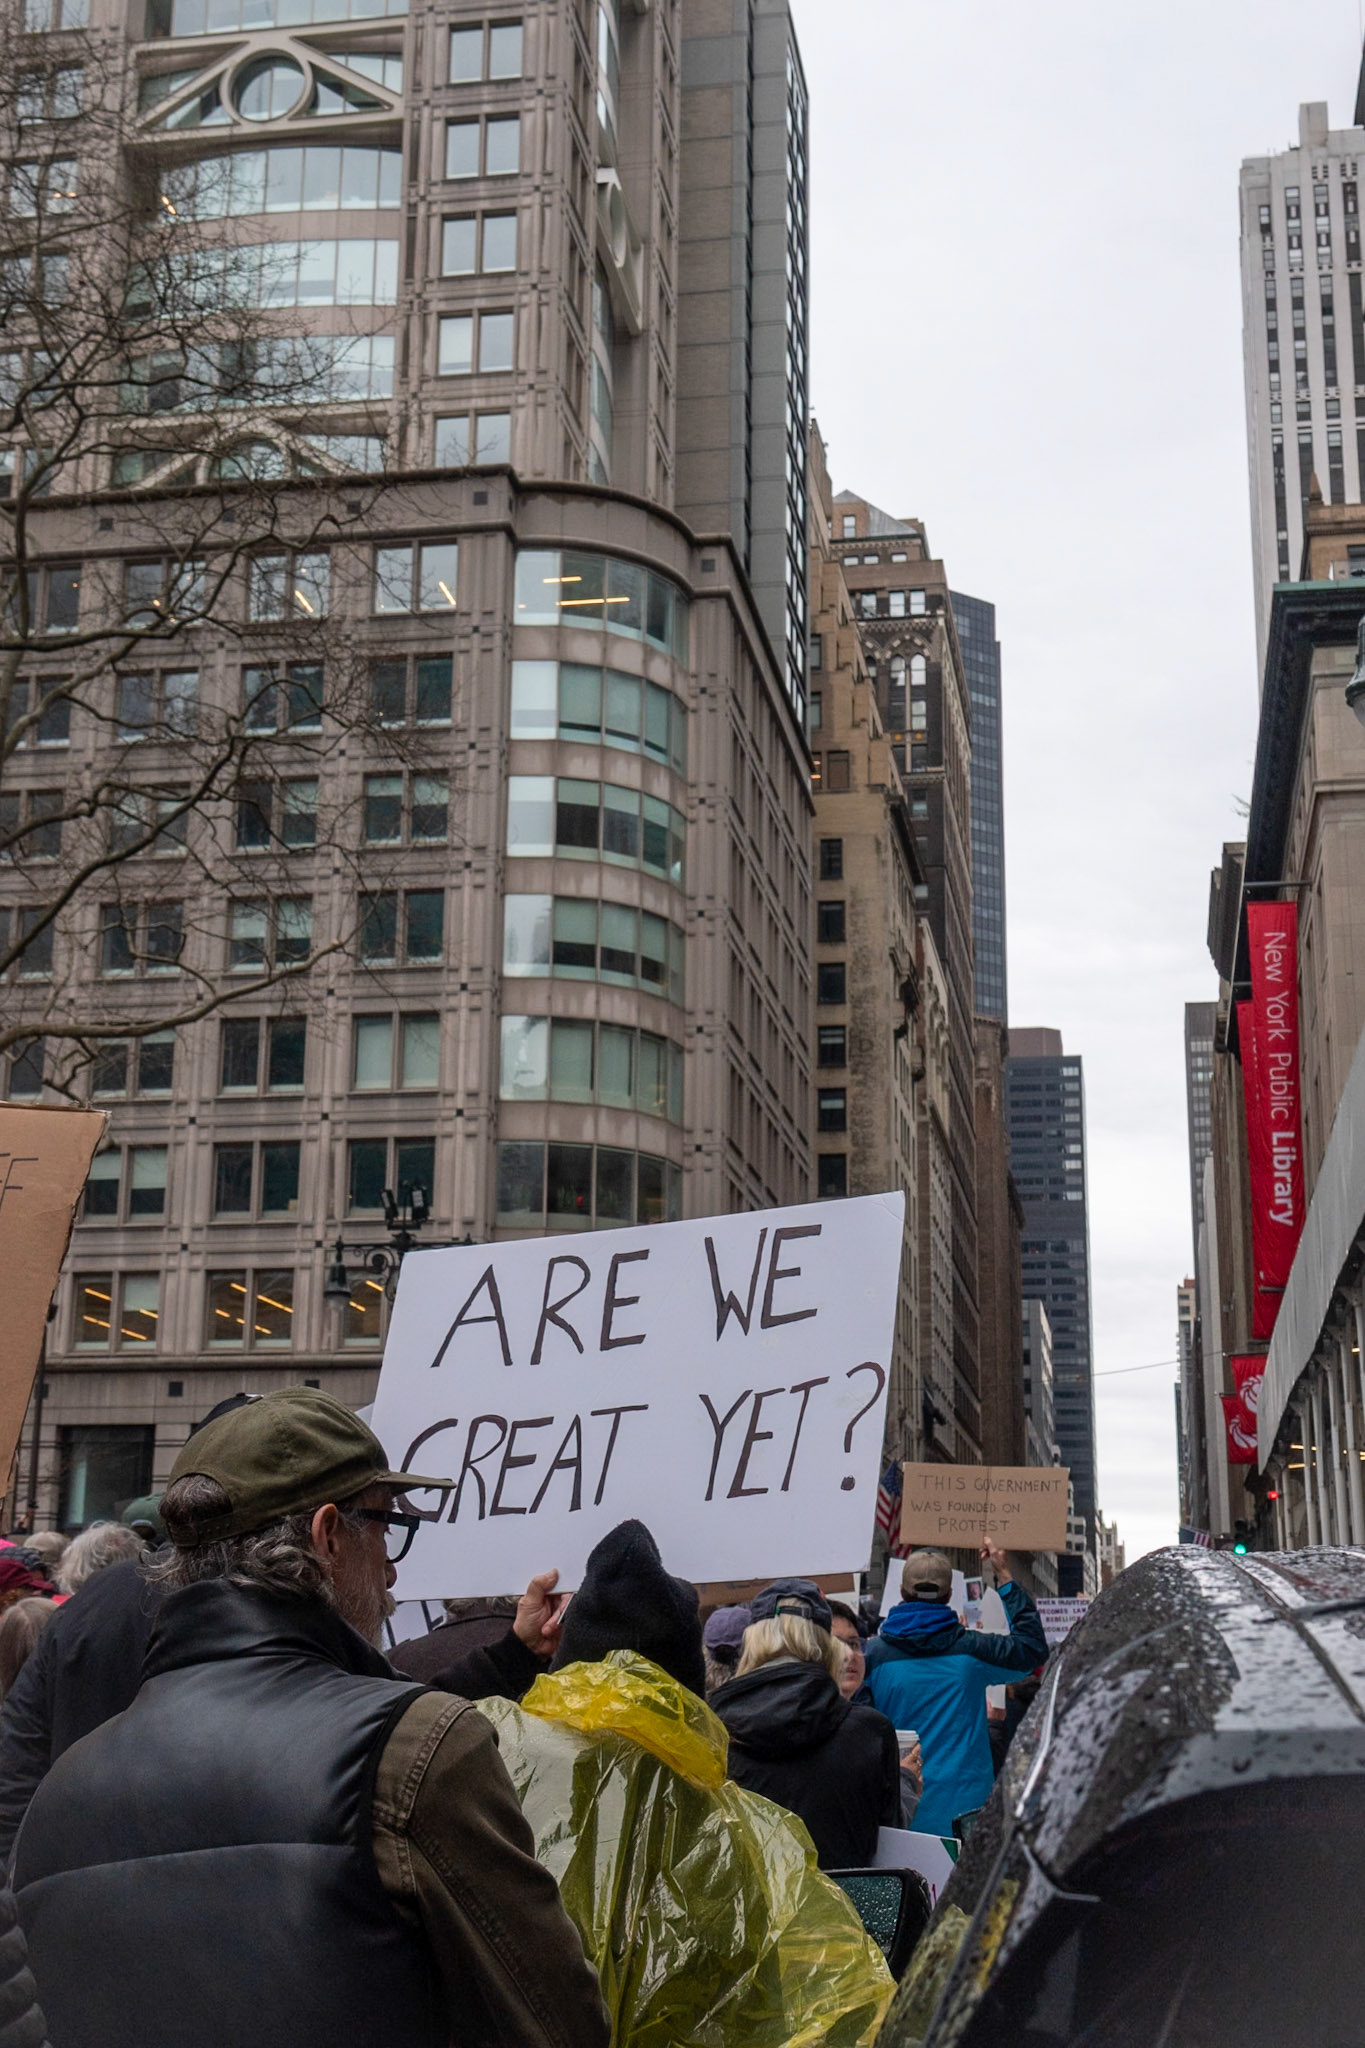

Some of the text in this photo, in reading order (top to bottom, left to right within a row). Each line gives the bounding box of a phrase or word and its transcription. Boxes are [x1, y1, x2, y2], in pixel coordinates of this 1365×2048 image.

[1263, 931, 1296, 1227] New York Public Library
[431, 1224, 822, 1367] ARE WE
[397, 1361, 886, 1524] GREAT YET?
[911, 1501, 1021, 1514] WAS FOUNDED ON
[919, 1475, 1062, 1493] THIS GOVERNMENT
[938, 1518, 1011, 1532] PROTEST
